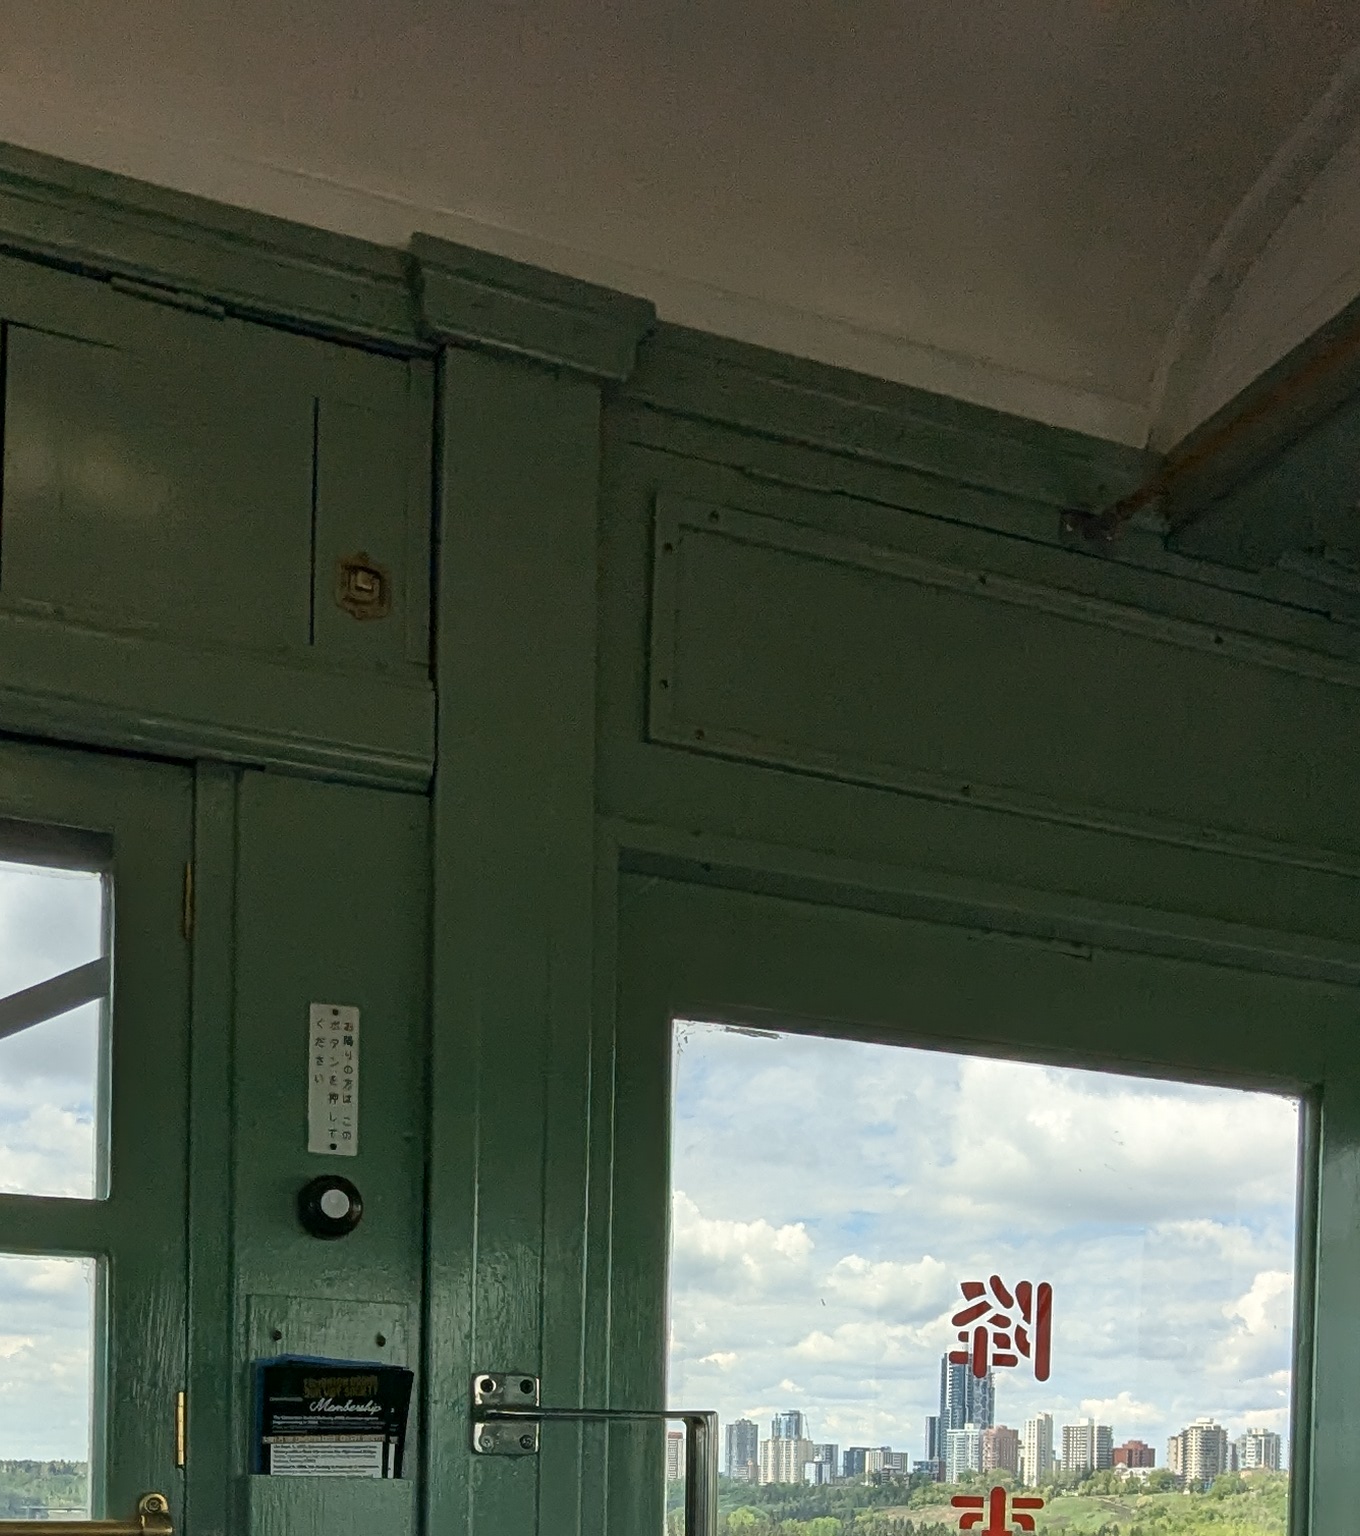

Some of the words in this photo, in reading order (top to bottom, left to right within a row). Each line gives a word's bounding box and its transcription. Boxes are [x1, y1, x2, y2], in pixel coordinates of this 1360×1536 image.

[314, 1018, 325, 1084] ください
[309, 1396, 382, 1416] Membership
